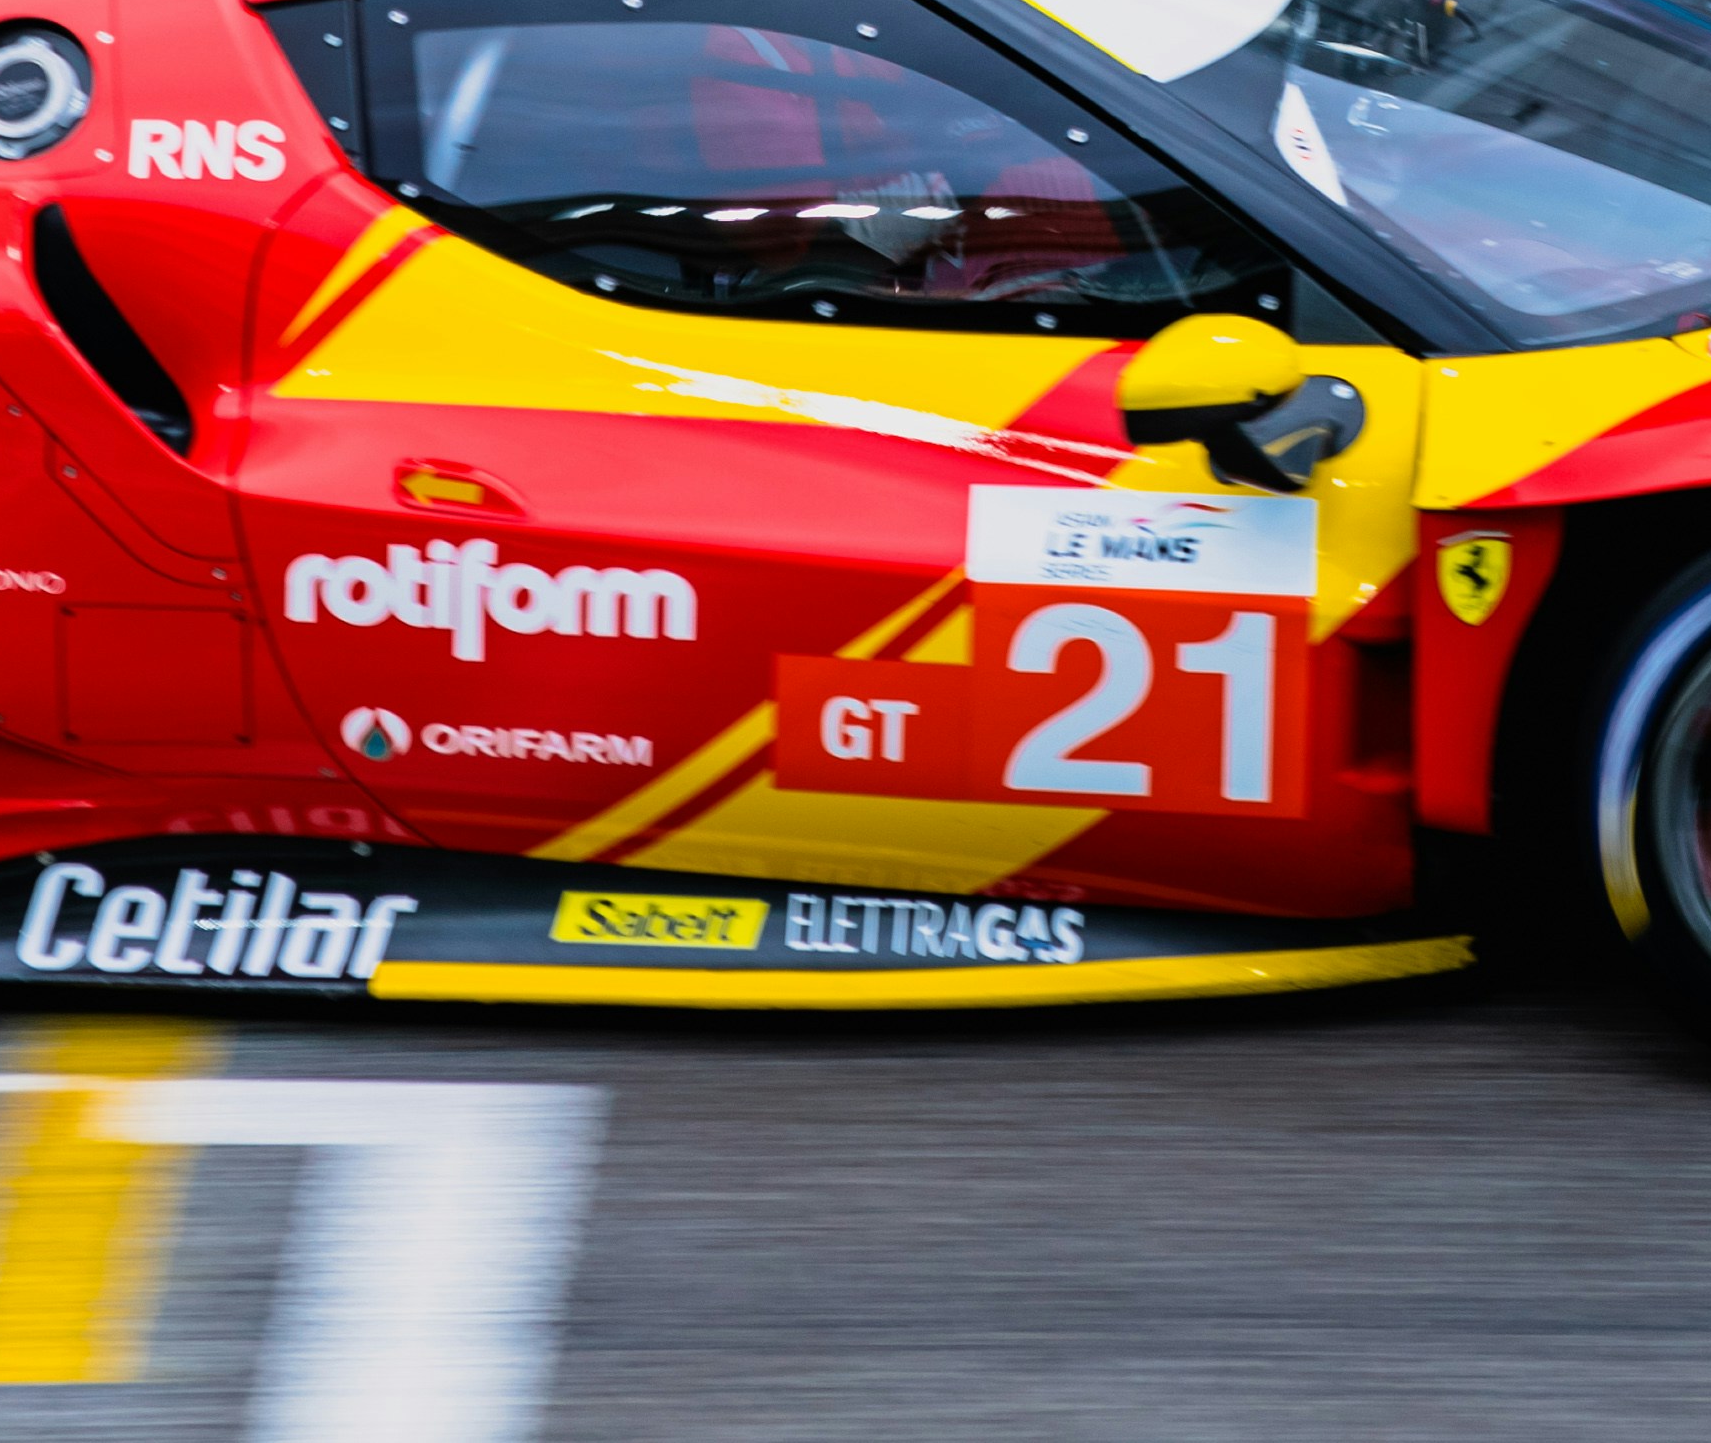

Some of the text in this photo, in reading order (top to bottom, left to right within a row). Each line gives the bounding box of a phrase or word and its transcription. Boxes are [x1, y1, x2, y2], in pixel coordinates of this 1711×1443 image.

[128, 119, 287, 181] RNS
[1100, 535, 1202, 563] MANS
[284, 538, 697, 662] rotiform
[820, 695, 920, 762] GT
[1002, 602, 1277, 802] 21
[420, 722, 653, 767] ORIFARM
[16, 862, 419, 980] Cetilar
[575, 899, 744, 943] Sabelt
[785, 892, 1085, 965] ELETTRAGAS
